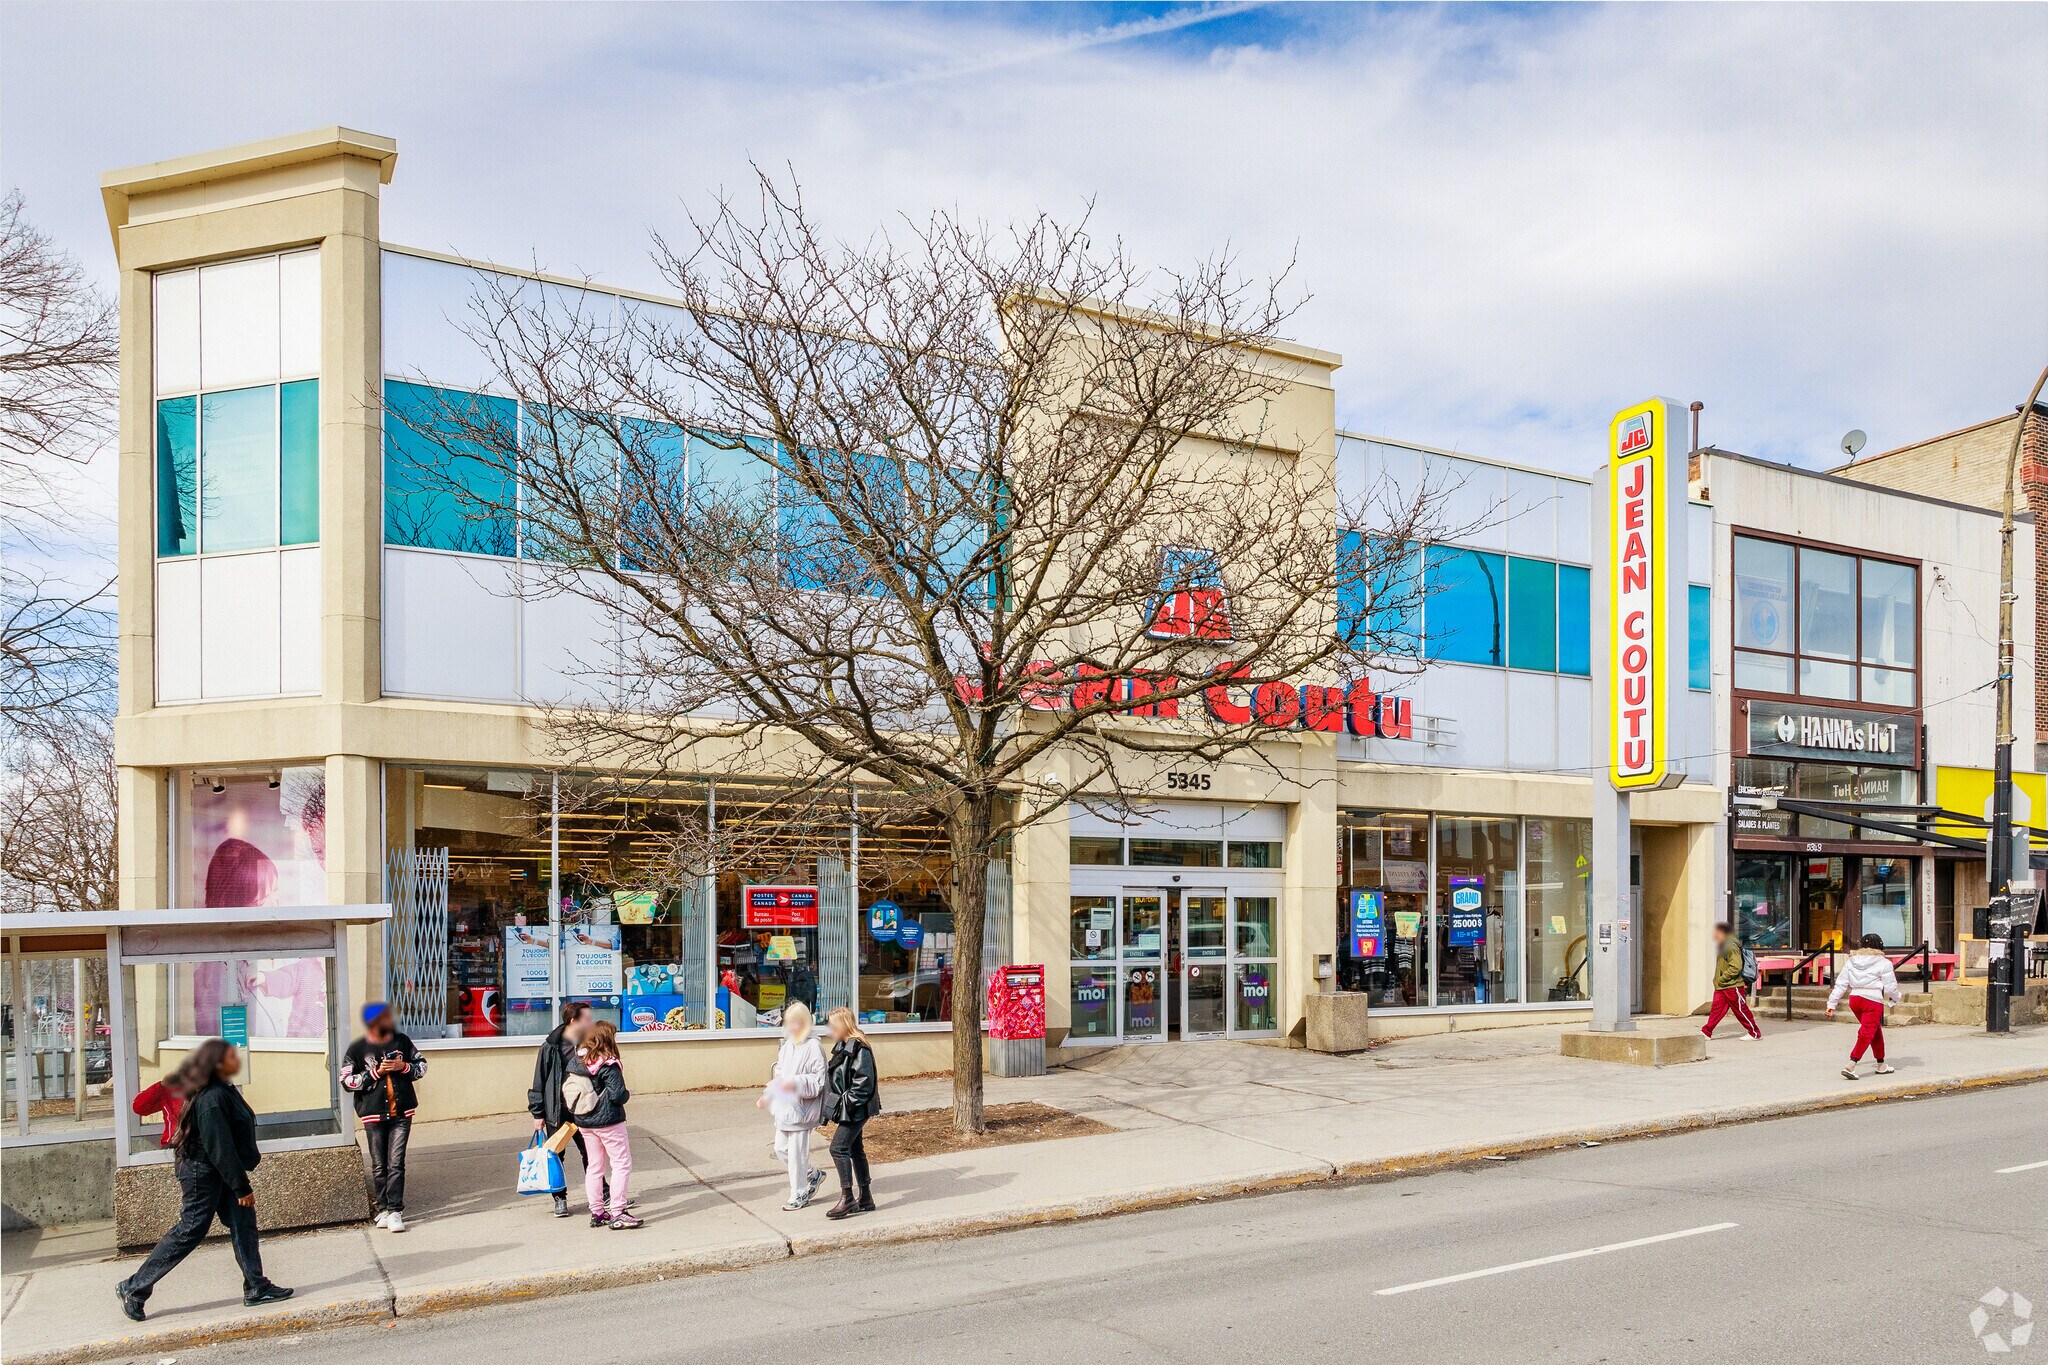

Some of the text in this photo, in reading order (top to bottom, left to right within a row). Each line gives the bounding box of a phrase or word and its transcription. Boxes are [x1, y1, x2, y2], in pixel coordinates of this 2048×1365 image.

[1622, 464, 1648, 769] JEAN COUTU
[1204, 660, 1413, 740] Coutu
[1167, 772, 1211, 791] 5345
[1738, 808, 1761, 818] SMOOTHIES
[1738, 820, 1756, 829] SALADES
[1762, 821, 1780, 830] PLANTES
[1455, 892, 1479, 905] GRAND
[1078, 985, 1105, 1001] moi
[1243, 983, 1268, 997] moi
[1131, 1013, 1155, 1027] moi
